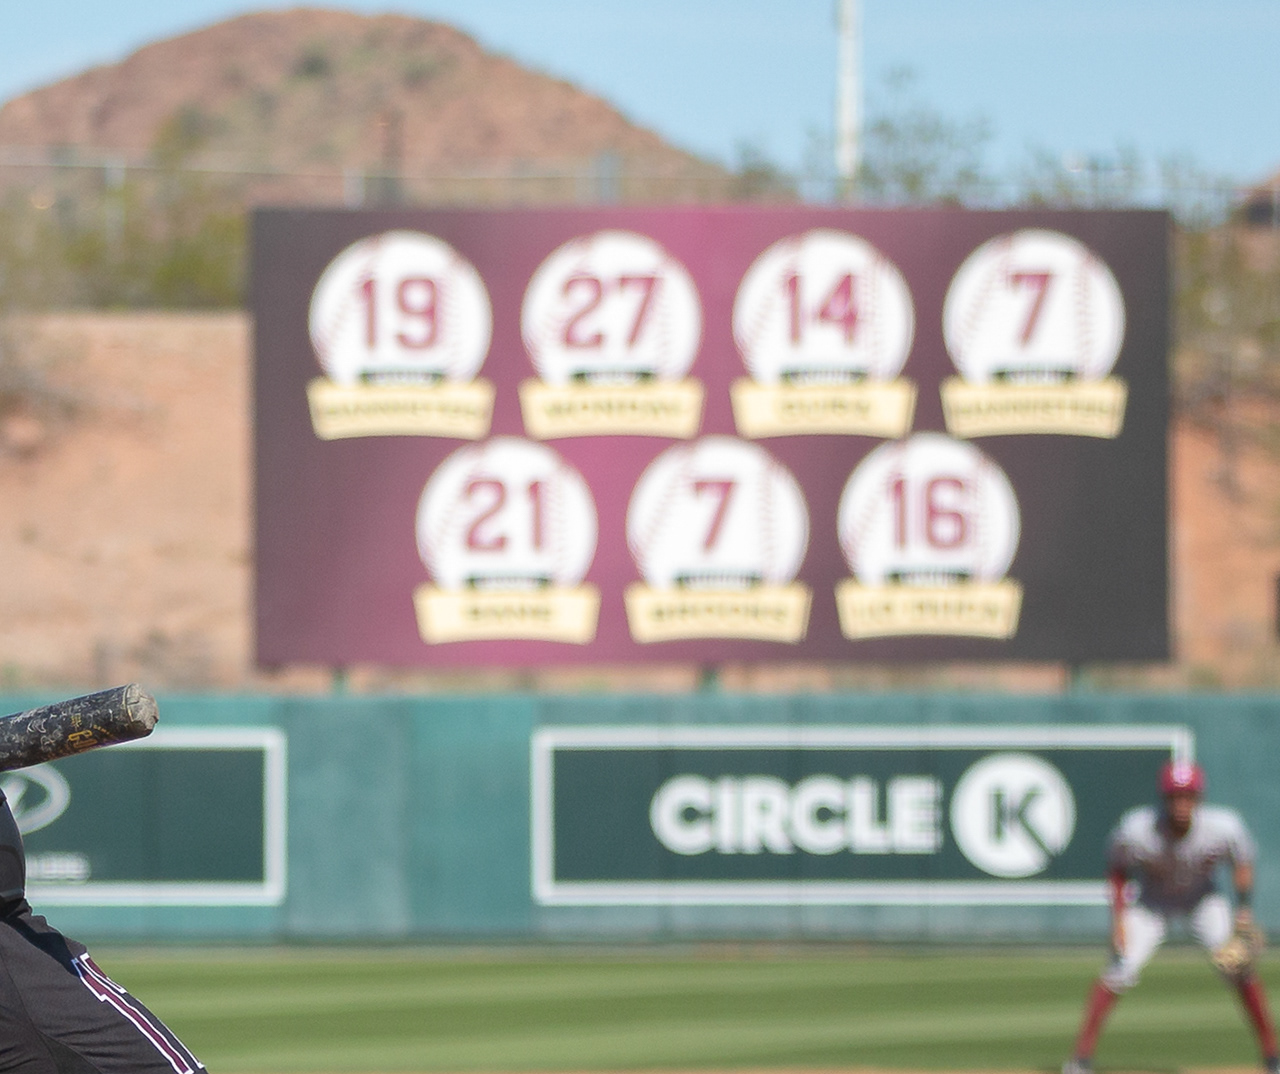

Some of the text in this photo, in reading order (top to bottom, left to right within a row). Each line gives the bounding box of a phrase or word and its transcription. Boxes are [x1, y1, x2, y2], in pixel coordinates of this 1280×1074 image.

[360, 274, 444, 352] 19
[559, 274, 663, 352] 27
[782, 272, 863, 350] 14
[1006, 270, 1055, 349] 7
[462, 477, 549, 555] 21
[692, 477, 739, 555] 7
[886, 476, 970, 553] 16
[649, 773, 944, 856] CIRCLE
